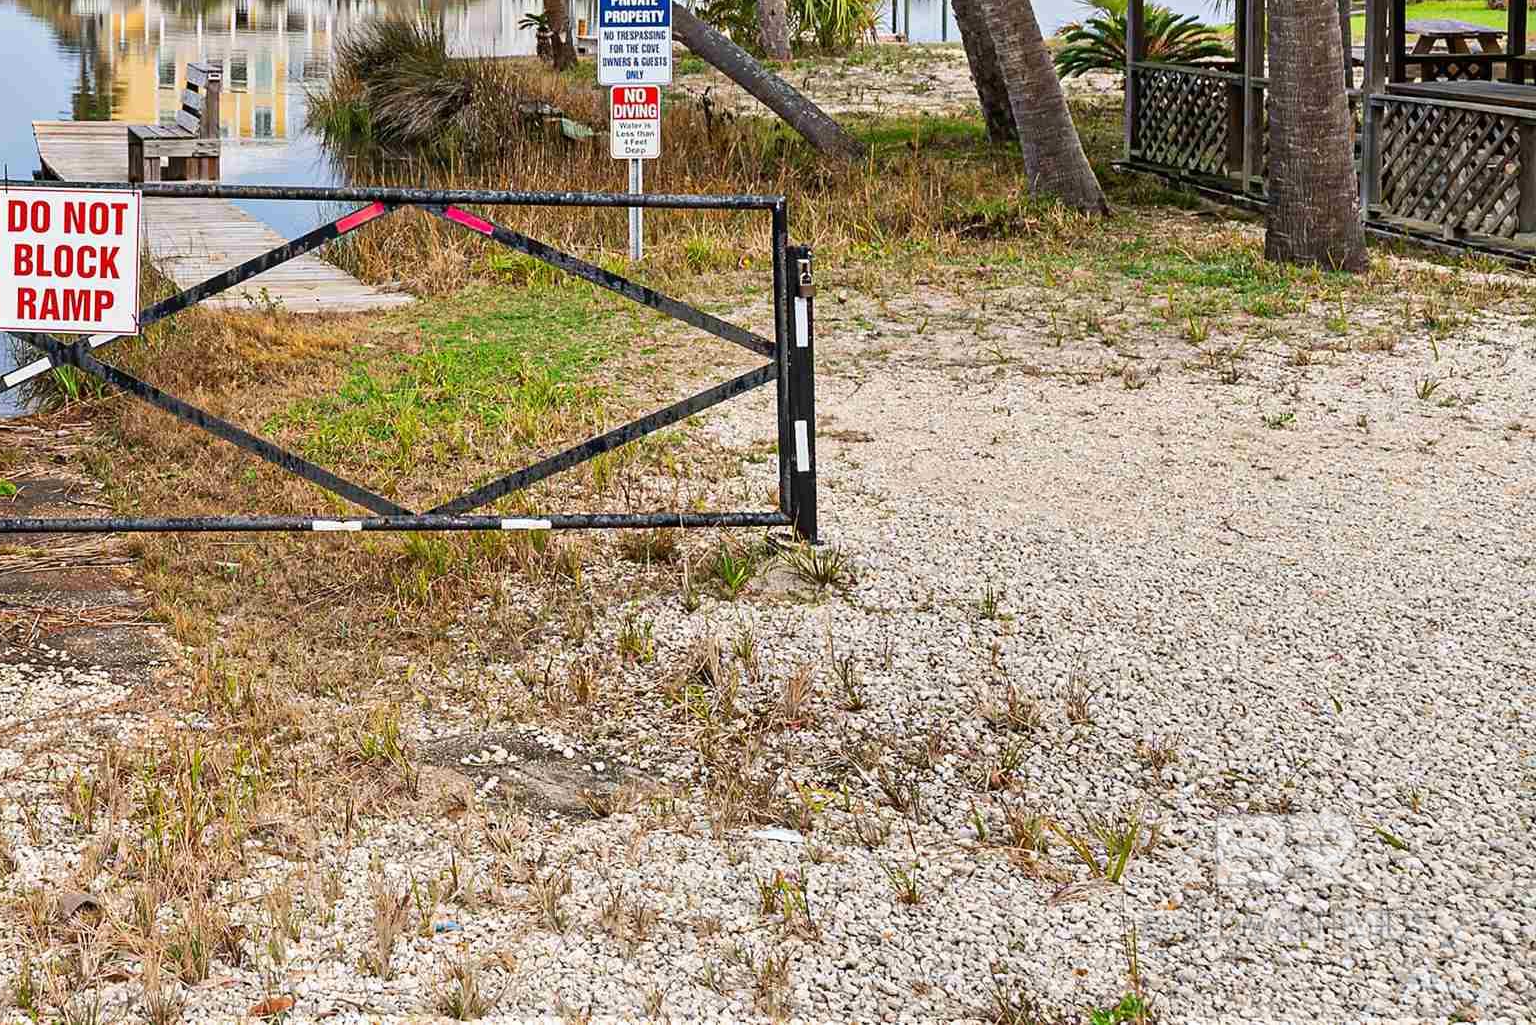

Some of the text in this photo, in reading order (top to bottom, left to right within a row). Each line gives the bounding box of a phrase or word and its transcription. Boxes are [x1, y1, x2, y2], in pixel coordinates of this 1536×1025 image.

[604, 9, 665, 23] PROPERTY
[604, 30, 666, 41] NO TRESPASSING
[609, 44, 660, 54] FOR THE COVE
[602, 57, 631, 67] OWNERS
[641, 57, 667, 67] GUESTS
[625, 70, 644, 80] ONLY
[624, 88, 647, 103] NO
[613, 103, 658, 119] DIVING
[618, 122, 642, 130] Water
[616, 130, 635, 138] Less
[7, 200, 129, 236] DO NOT
[14, 243, 121, 280] BLOCK
[16, 287, 114, 323] RAMP
